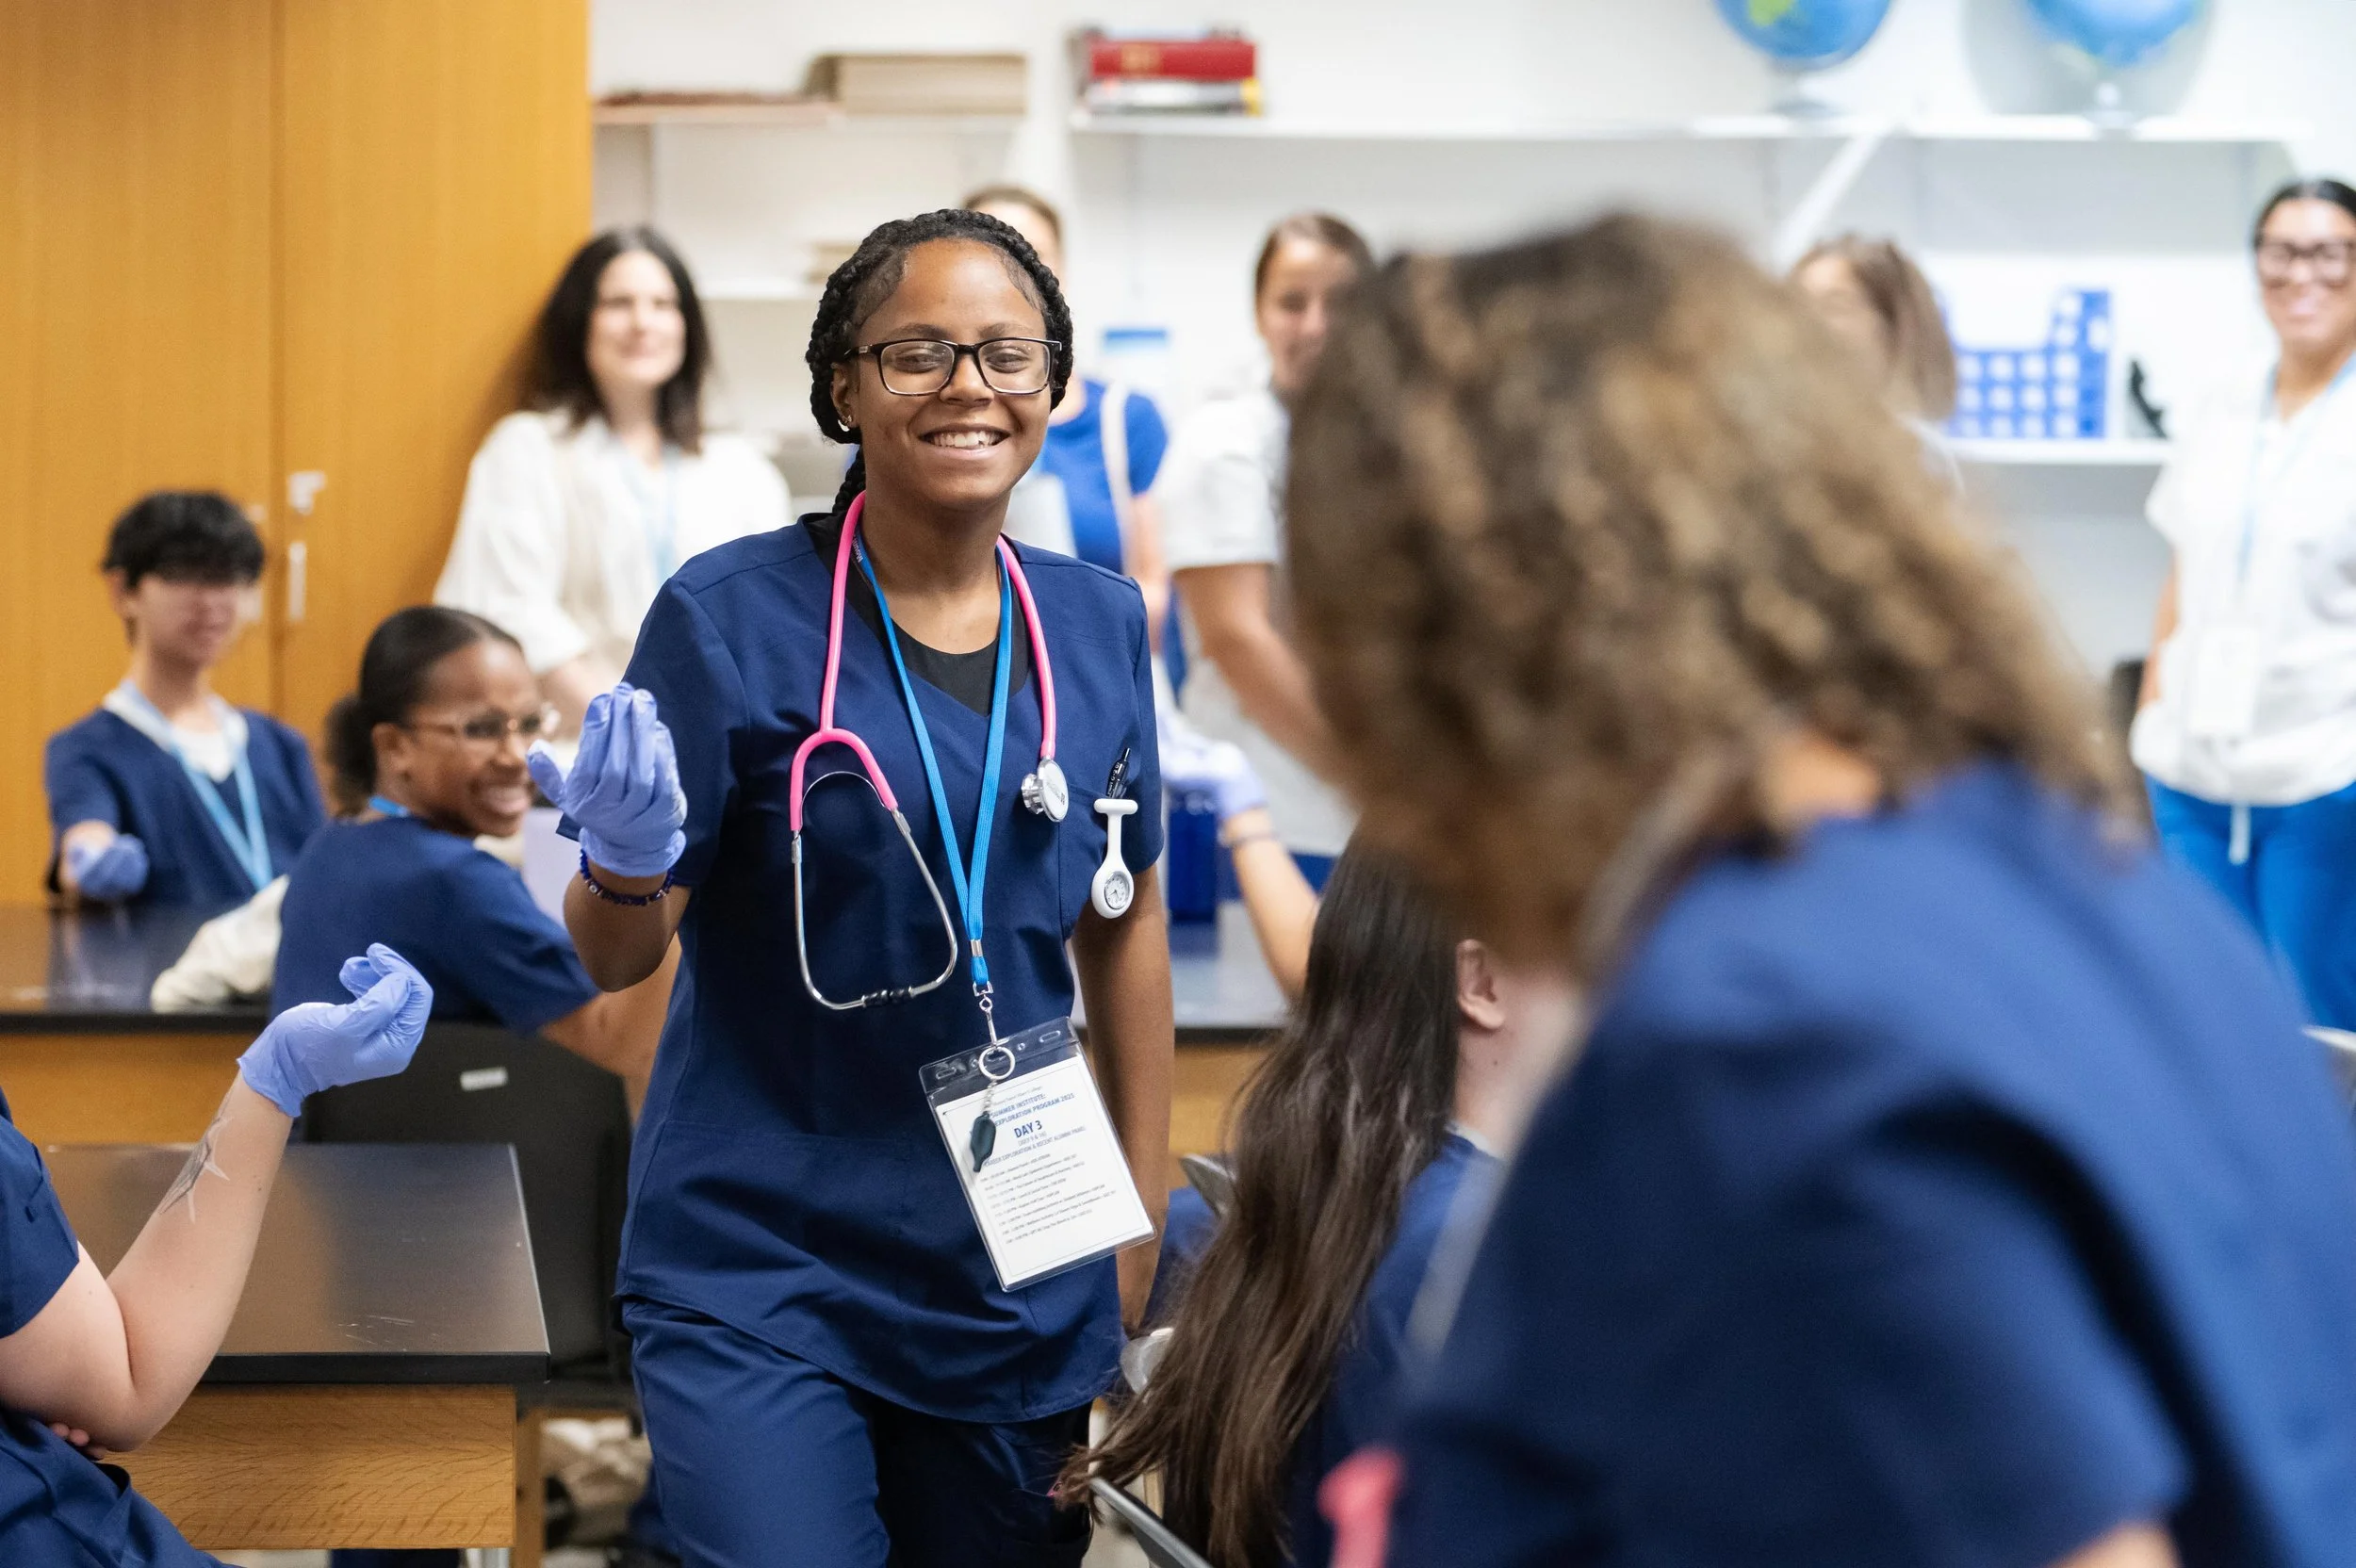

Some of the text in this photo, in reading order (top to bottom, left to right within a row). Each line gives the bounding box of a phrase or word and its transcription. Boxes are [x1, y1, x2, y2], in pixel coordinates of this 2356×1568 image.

[1033, 1098, 1059, 1112] PROGRAM
[1014, 1119, 1042, 1138] DAY 3
